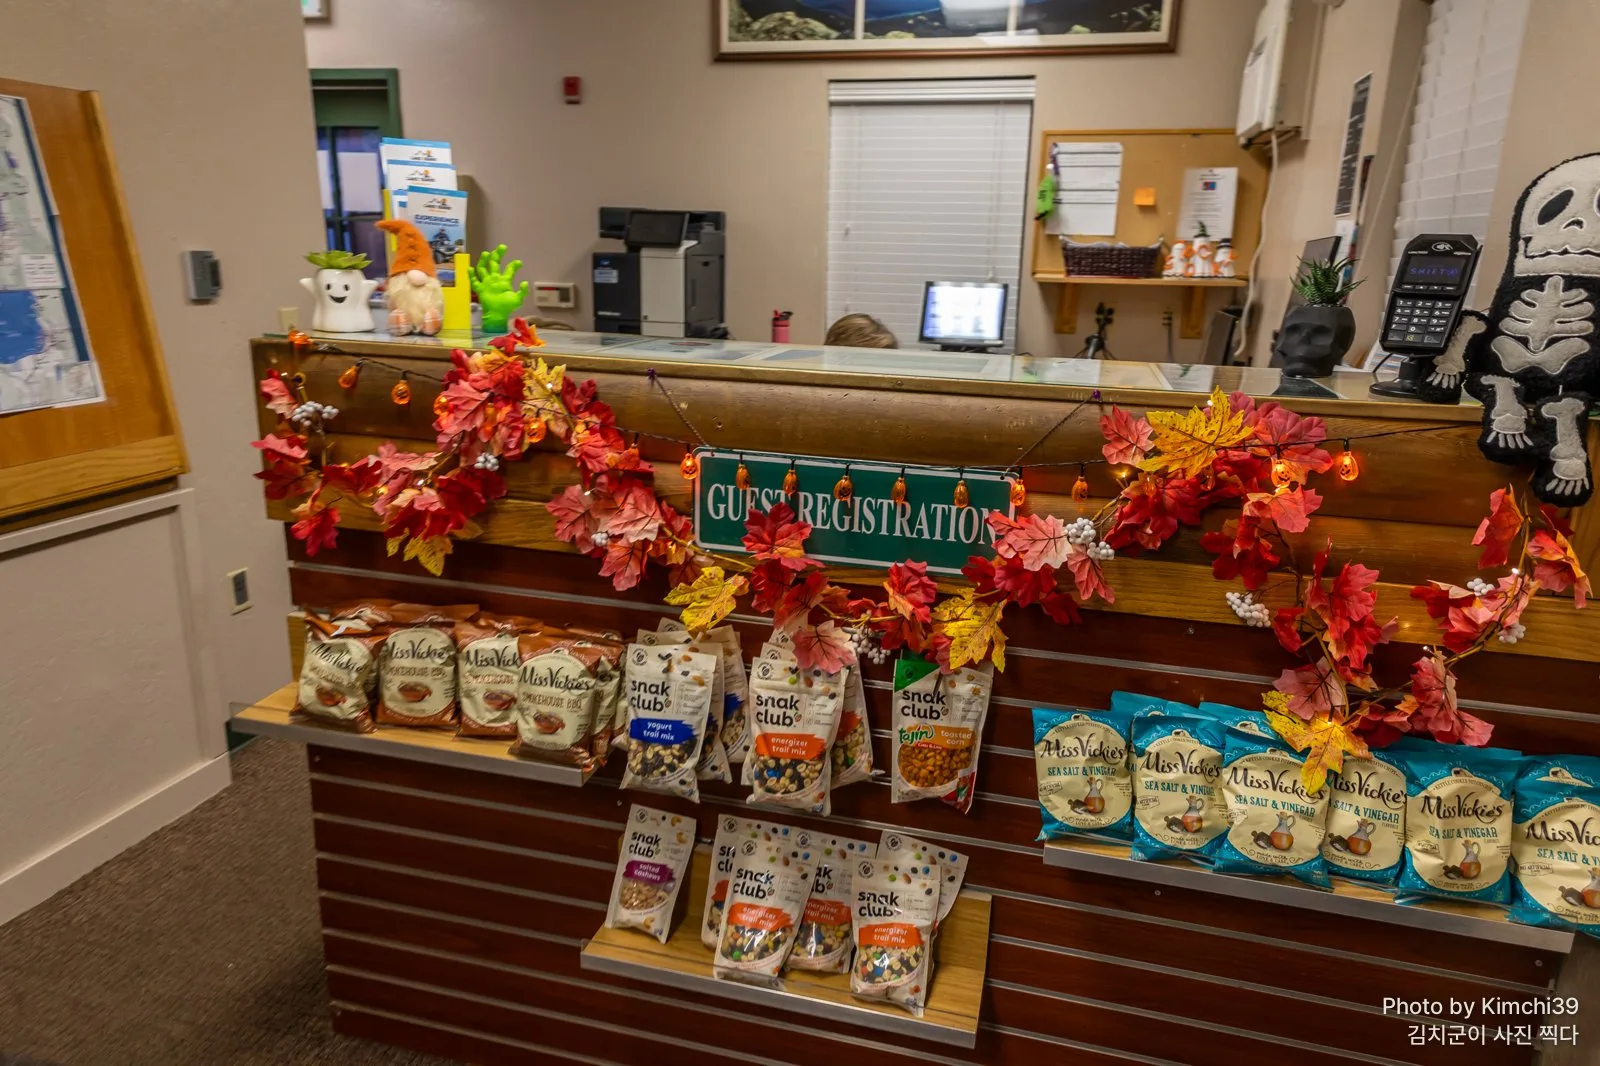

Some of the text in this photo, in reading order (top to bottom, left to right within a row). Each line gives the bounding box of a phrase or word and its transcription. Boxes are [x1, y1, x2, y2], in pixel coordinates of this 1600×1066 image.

[798, 491, 1001, 546] REGISTRATION
[490, 645, 521, 669] Vick
[630, 679, 671, 697] snak
[630, 695, 664, 713] club
[756, 693, 800, 712] snak
[902, 689, 946, 706] snak
[756, 709, 794, 728] club
[901, 703, 941, 720] club
[647, 720, 673, 733] yogurt
[941, 729, 973, 740] toasted
[643, 730, 675, 741] trail mix
[771, 736, 808, 748] energizer
[772, 745, 806, 756] trail mix
[1047, 767, 1061, 776] SEA
[1063, 766, 1079, 776] SALT
[1082, 766, 1089, 777] &
[1145, 781, 1159, 791] SEA
[1161, 782, 1180, 793] SALT
[1181, 784, 1188, 794] &
[1264, 769, 1325, 805] Vickis
[1235, 795, 1316, 818] SEA SALT & VINEGAR
[1333, 800, 1400, 825] SALT & VINEGAR
[630, 830, 662, 847] snak
[1456, 828, 1463, 838] &
[1463, 826, 1498, 838] VINEGAR
[628, 841, 655, 859] club
[719, 844, 736, 858] sn
[1537, 848, 1554, 860] SEA
[1557, 850, 1578, 863] SALT
[1581, 854, 1591, 866] &
[718, 858, 732, 873] cl
[736, 866, 775, 885] snak
[733, 881, 767, 900] club
[858, 890, 900, 906] snak
[807, 902, 838, 914] nergizer
[858, 902, 894, 917] club
[873, 933, 906, 943] trail mix
[874, 927, 908, 935] energizer
